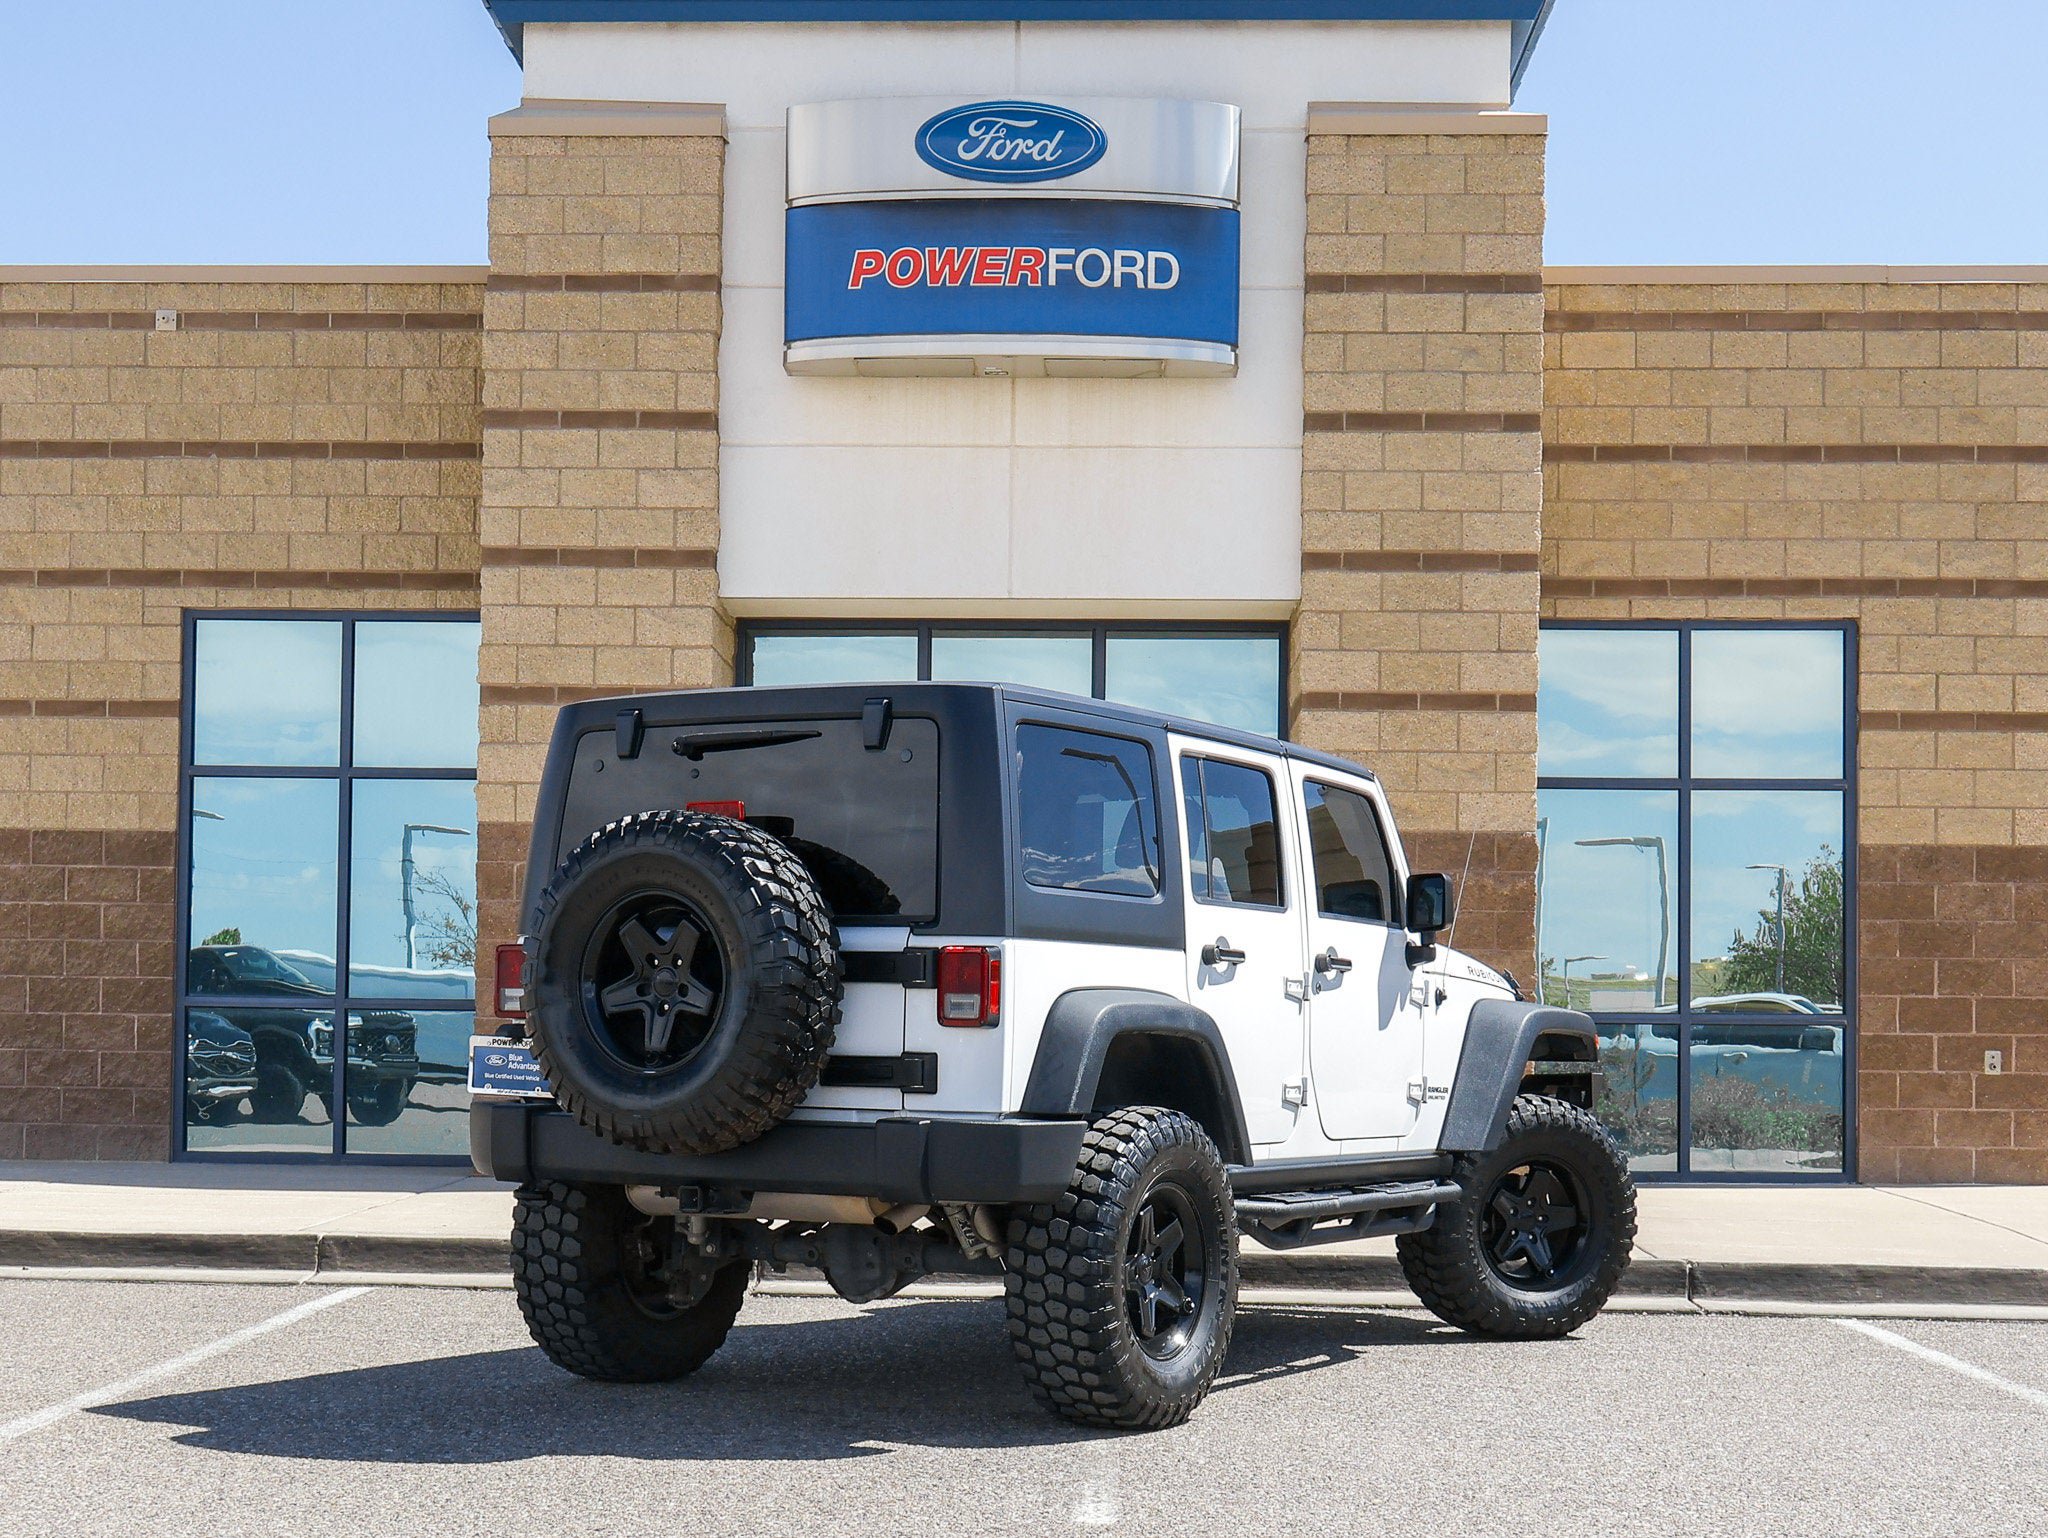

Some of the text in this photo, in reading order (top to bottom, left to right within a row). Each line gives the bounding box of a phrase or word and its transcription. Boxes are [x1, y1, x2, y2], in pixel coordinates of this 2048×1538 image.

[957, 117, 1065, 161] Ford
[848, 247, 1180, 290] POWERFORD
[508, 1053, 523, 1062] Blue
[508, 1062, 540, 1072] Advantage
